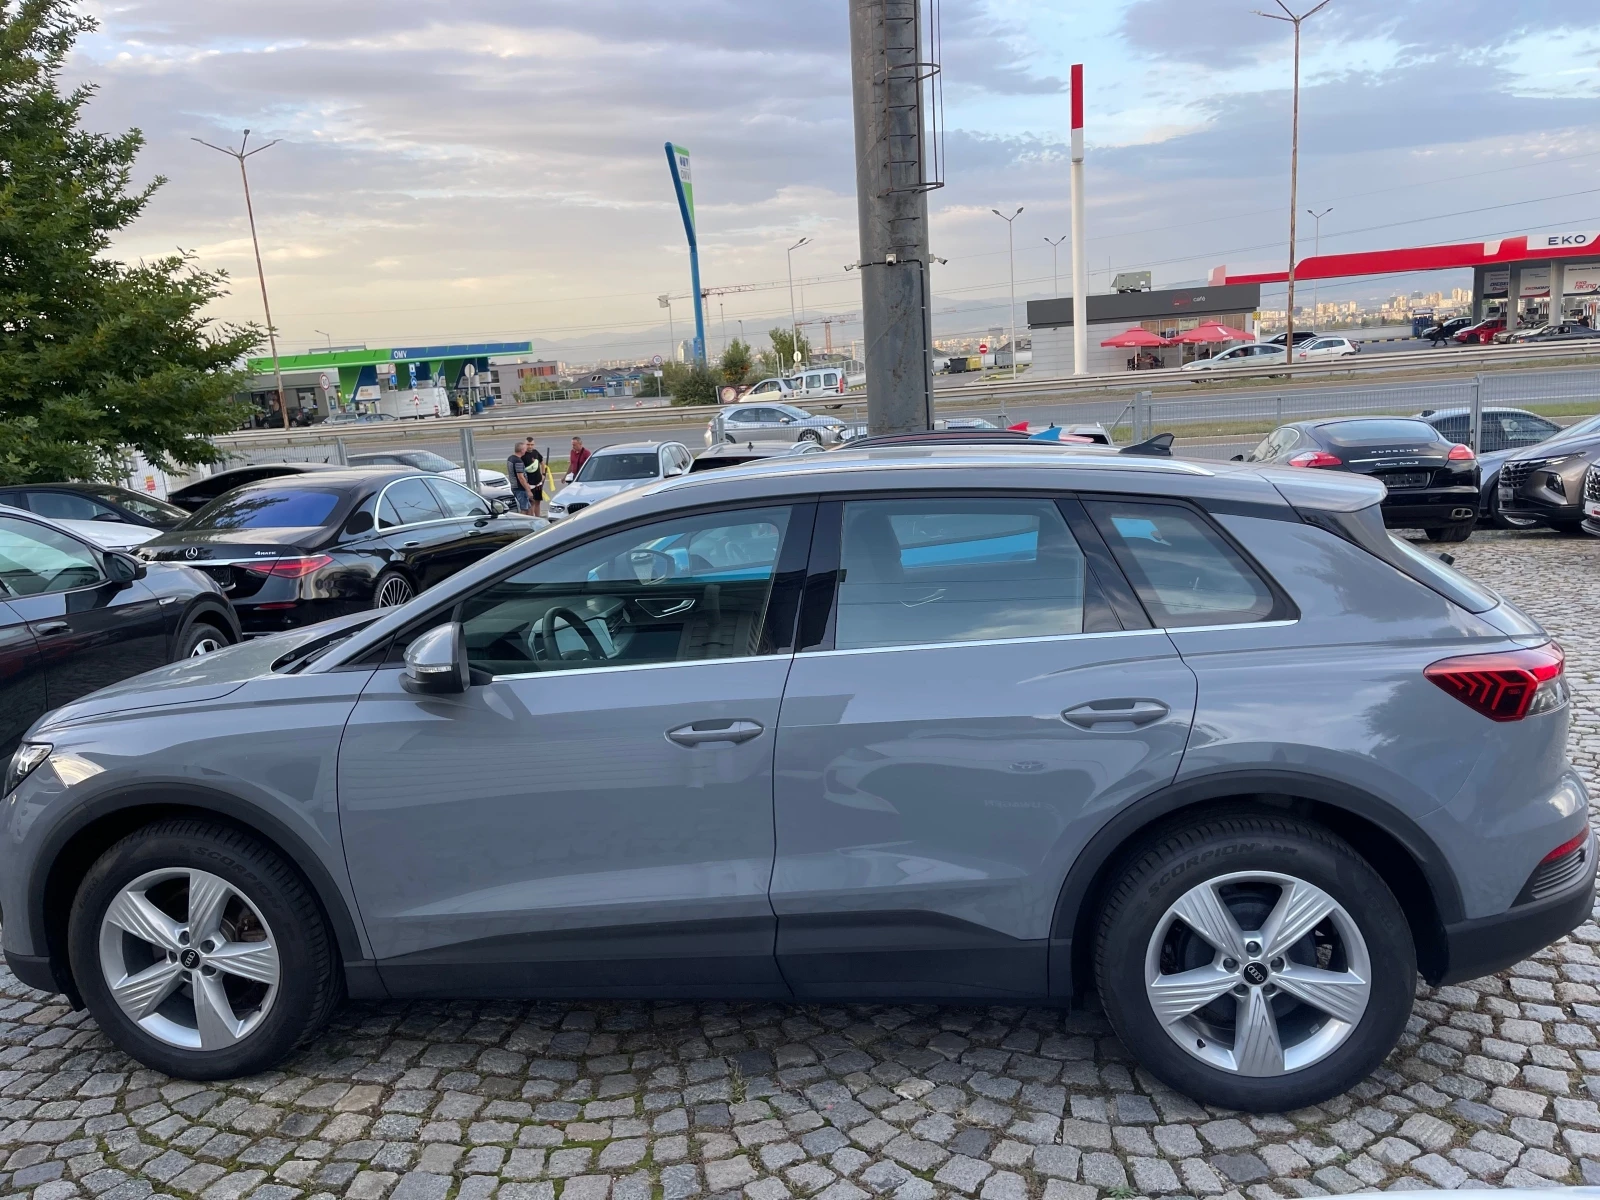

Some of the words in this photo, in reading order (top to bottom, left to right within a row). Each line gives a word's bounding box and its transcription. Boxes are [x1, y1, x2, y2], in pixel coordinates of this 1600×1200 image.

[1548, 234, 1586, 246] EKO
[393, 350, 408, 359] OMV
[192, 846, 282, 909] SCORPION
[1148, 842, 1256, 899] SCORPION
